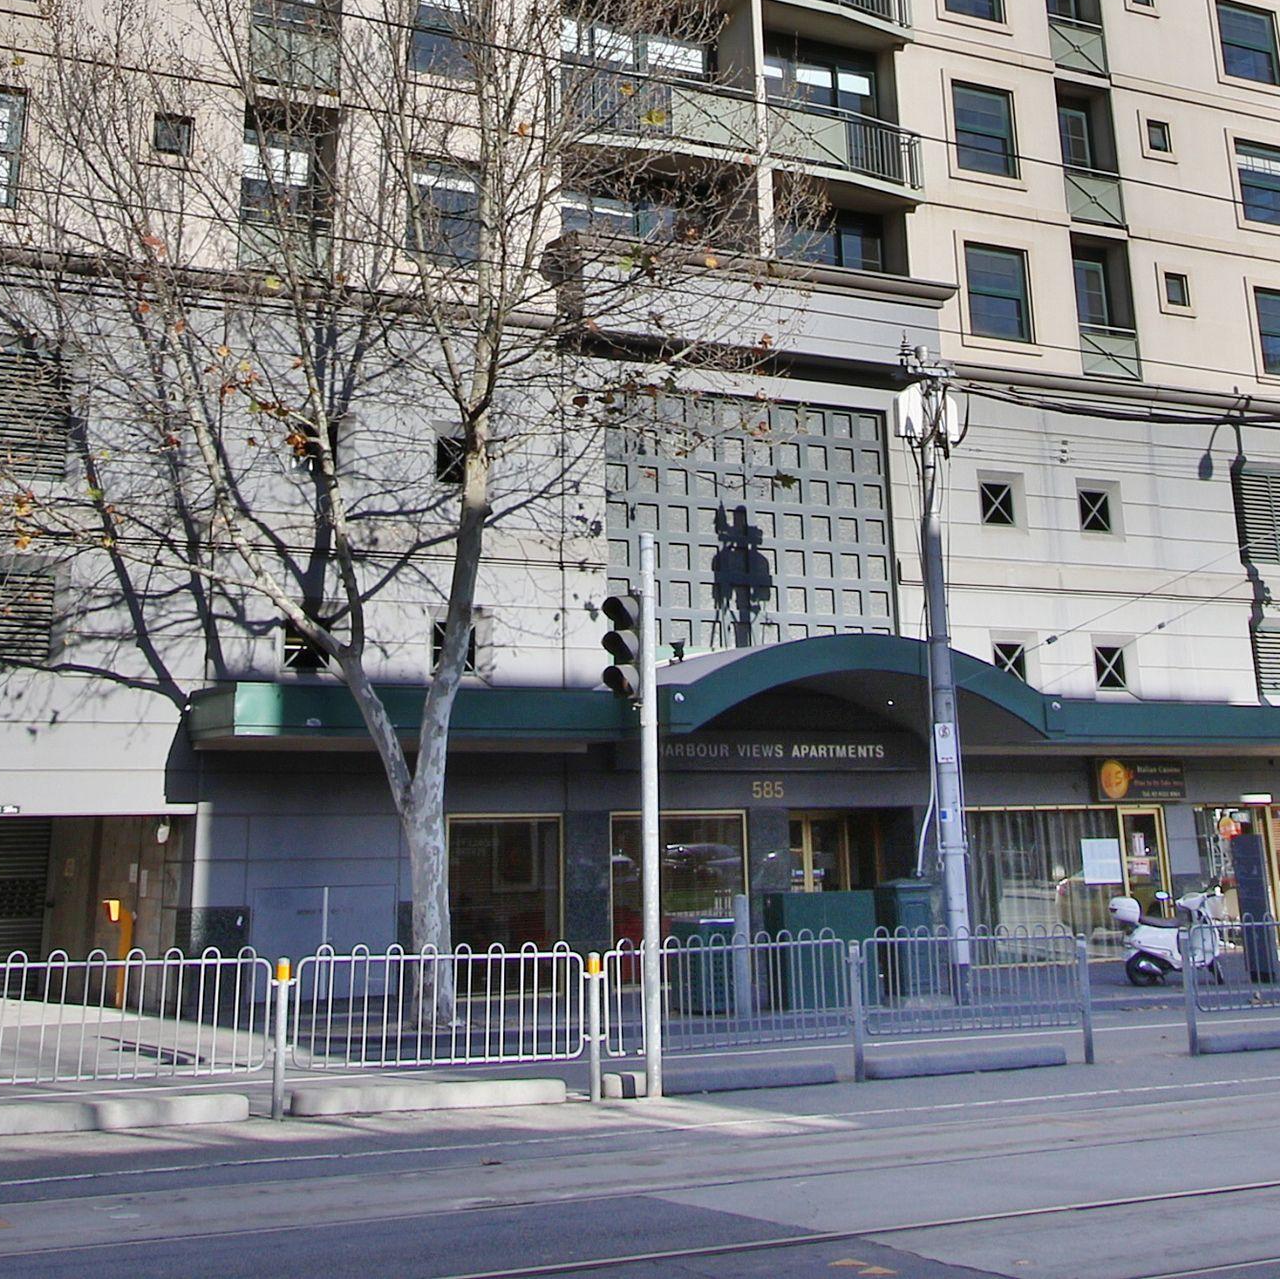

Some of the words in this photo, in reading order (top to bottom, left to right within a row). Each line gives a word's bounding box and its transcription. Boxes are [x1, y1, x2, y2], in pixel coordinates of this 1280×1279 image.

[737, 744, 783, 758] VIEWS
[792, 745, 885, 758] APARTMENTS
[752, 781, 784, 799] 585
